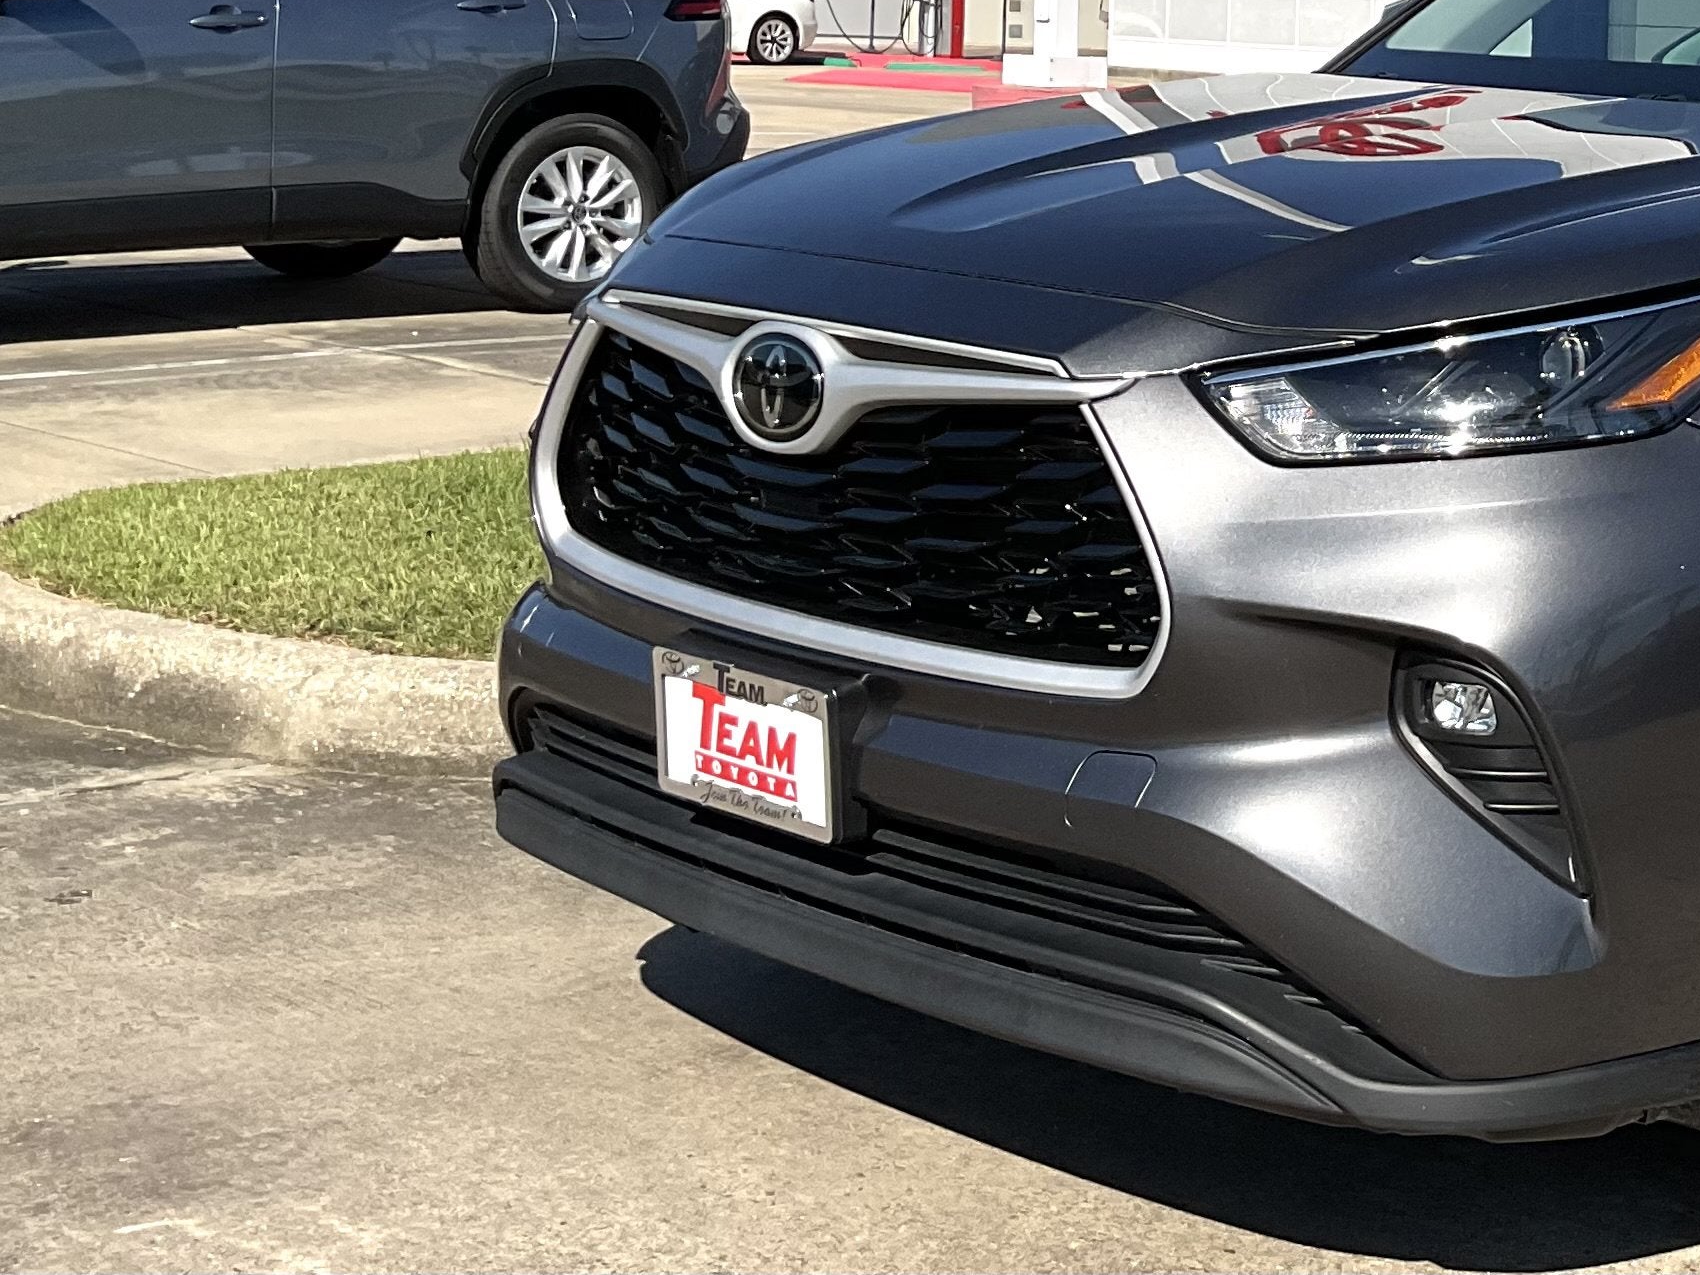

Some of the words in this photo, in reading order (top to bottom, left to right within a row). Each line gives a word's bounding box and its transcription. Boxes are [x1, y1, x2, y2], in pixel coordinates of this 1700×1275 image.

[713, 662, 766, 705] TEAM
[692, 681, 797, 776] TEAM
[695, 753, 797, 799] TOYOTA
